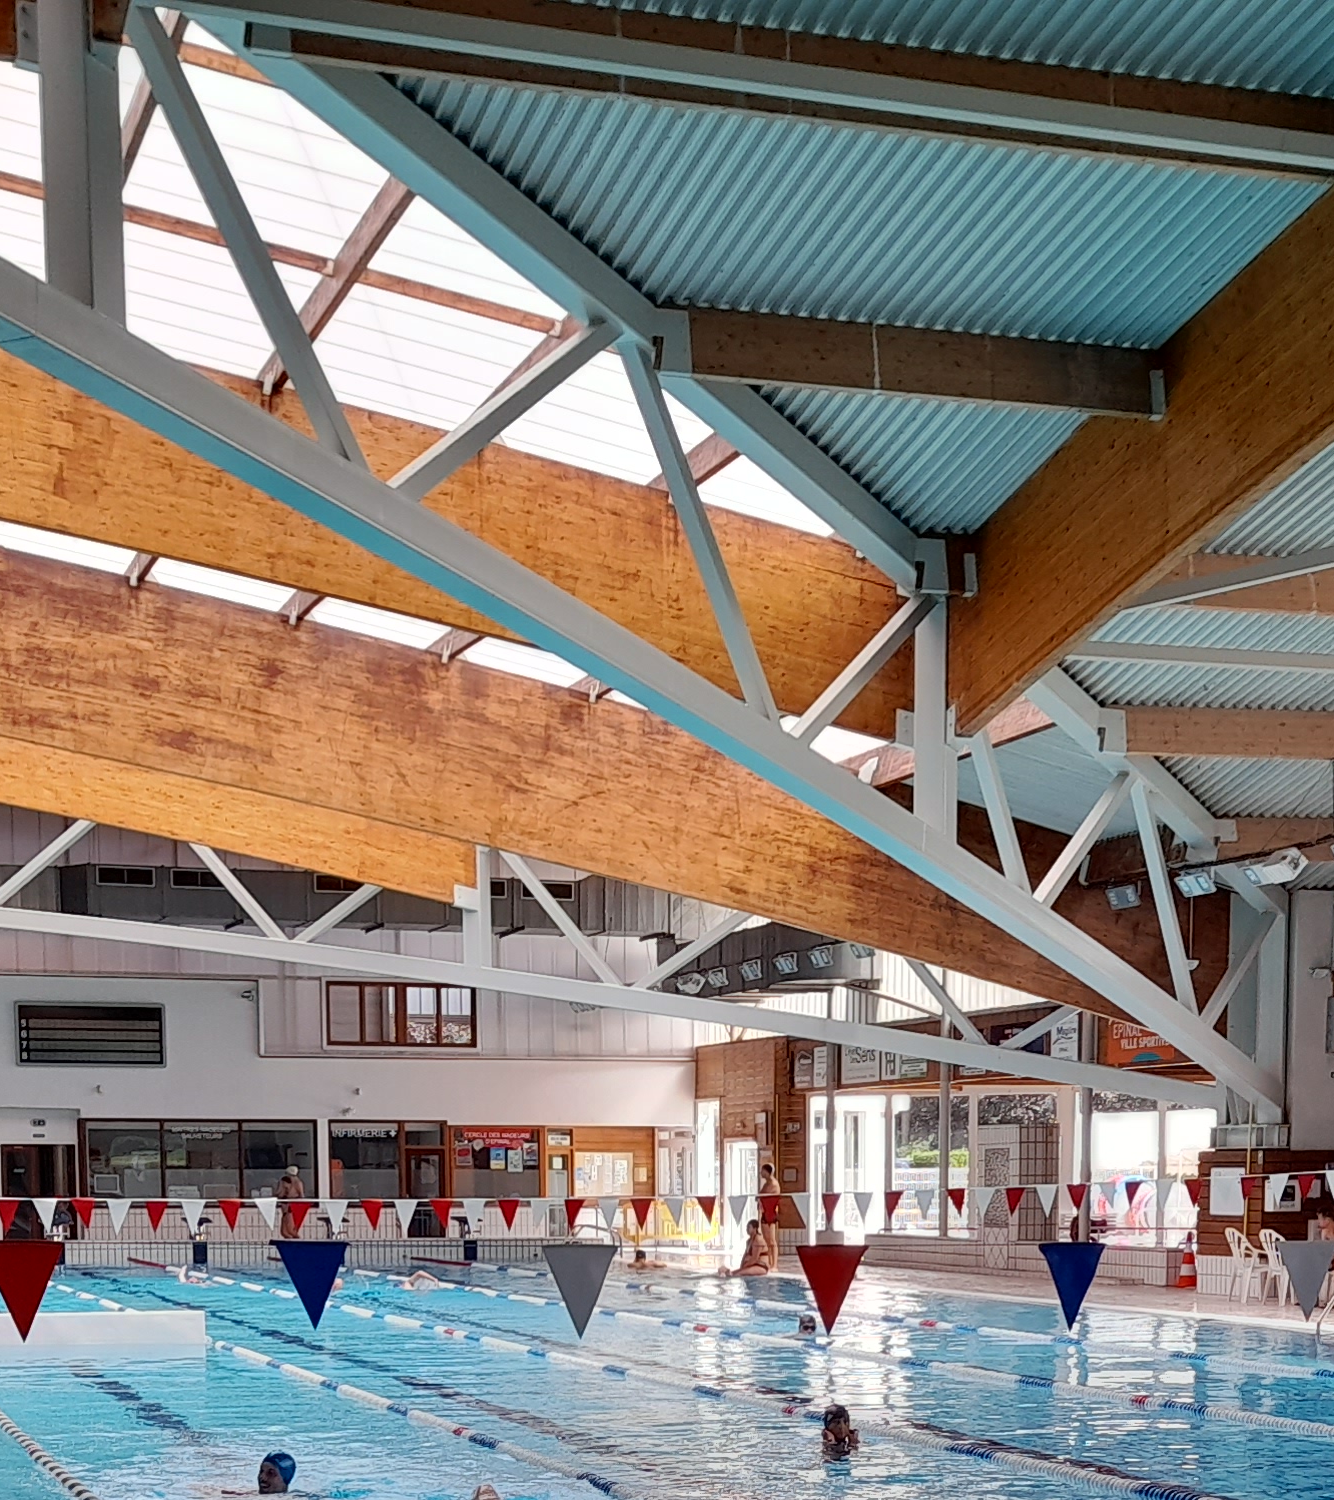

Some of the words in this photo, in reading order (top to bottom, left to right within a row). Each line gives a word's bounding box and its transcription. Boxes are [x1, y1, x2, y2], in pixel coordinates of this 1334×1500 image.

[20, 1018, 27, 1028] 5
[21, 1040, 28, 1049] 7
[331, 1128, 388, 1138] INFIRMERIE
